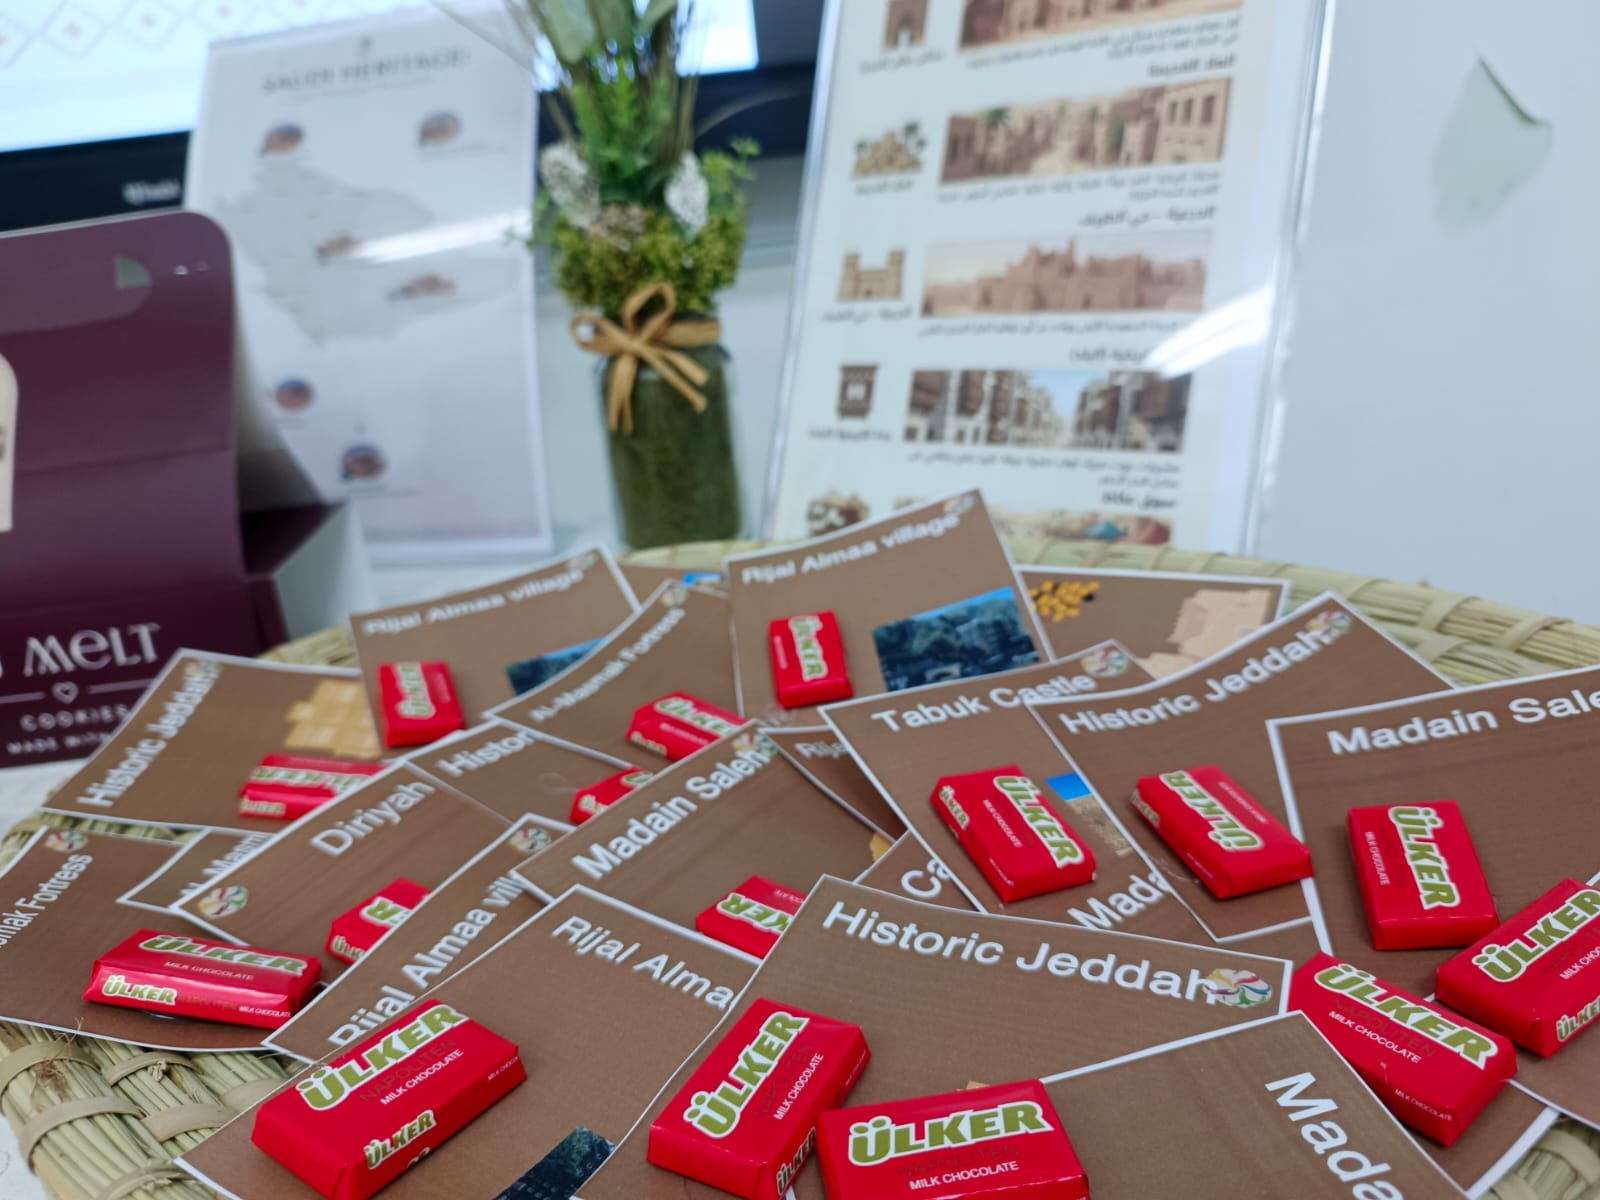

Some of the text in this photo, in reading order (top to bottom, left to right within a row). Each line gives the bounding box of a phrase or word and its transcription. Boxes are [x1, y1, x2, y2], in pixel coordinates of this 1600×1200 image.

[741, 511, 961, 584] Rijal Almaa village
[871, 673, 1097, 732] Tabuk Castle
[1058, 628, 1334, 734] Historic Jeddah
[1327, 709, 1498, 755] Madain
[76, 738, 167, 807] Historic
[309, 781, 437, 857] Diriyah
[571, 747, 773, 880] Madain Saleh
[992, 775, 1085, 869] ÜLKER
[1159, 770, 1265, 853] ÜLKER
[14, 854, 94, 911] Fortress
[1387, 805, 1461, 910] ÜLKER
[138, 934, 308, 977] ÜLKER
[401, 908, 497, 989] Almaa
[551, 915, 735, 1010] Rijal Alma
[821, 900, 1218, 1006] Historic Jeddah
[1471, 888, 1600, 983] ÜLKER
[1559, 962, 1584, 980] MILK
[102, 974, 178, 1006] ÜLKER
[1314, 963, 1499, 1071] ÜLKER
[295, 1003, 471, 1112] ÜLKER
[1328, 1010, 1423, 1065] MILK CHOCOLATE
[379, 1048, 465, 1105] MILK CHOCOLATE
[682, 1010, 811, 1139] ÜLKER
[773, 1052, 825, 1121] MILK CHOCOLATE
[363, 1109, 438, 1170] ÜLKER
[848, 1100, 1055, 1167] ÜLKER
[908, 1160, 1020, 1191] MILK CHOCOLATE
